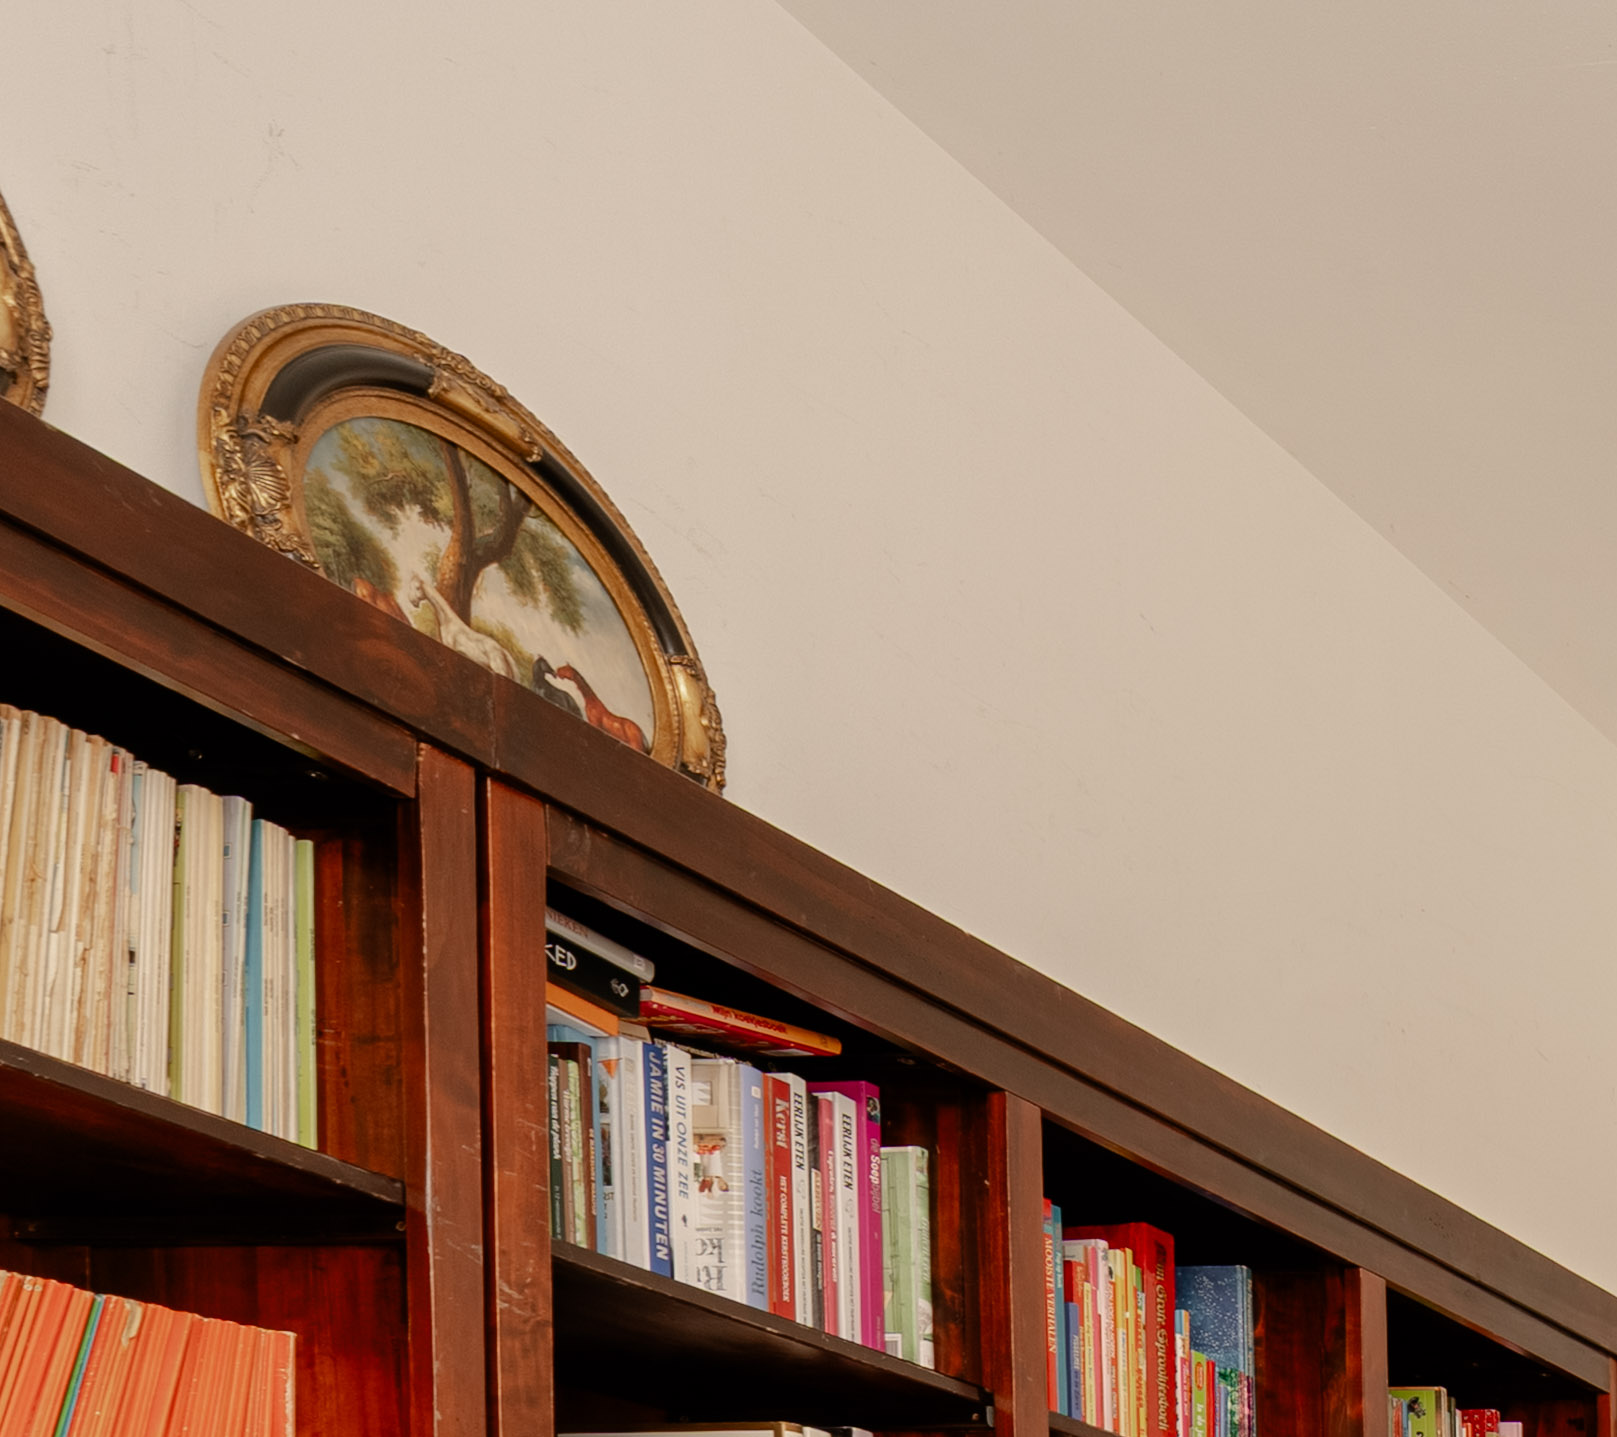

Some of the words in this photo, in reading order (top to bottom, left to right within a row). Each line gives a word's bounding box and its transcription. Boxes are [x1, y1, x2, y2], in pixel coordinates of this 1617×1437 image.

[649, 1052, 663, 1112] JAMIE
[675, 1067, 686, 1090] VIS
[676, 1095, 686, 1116] UIT
[776, 1098, 789, 1148] Kerst
[793, 1092, 804, 1139] EERLIJK
[651, 1118, 664, 1138] IN
[677, 1122, 687, 1166] ONZE
[842, 1113, 852, 1159] EERLIJK
[652, 1144, 664, 1162] 30
[795, 1141, 804, 1170] ETEN
[678, 1172, 688, 1199] ZEE
[843, 1161, 853, 1190] ETEN
[653, 1166, 669, 1260] MINUTEN
[1044, 1238, 1055, 1290] MOOISTE
[1046, 1293, 1056, 1352] VERHALEN
